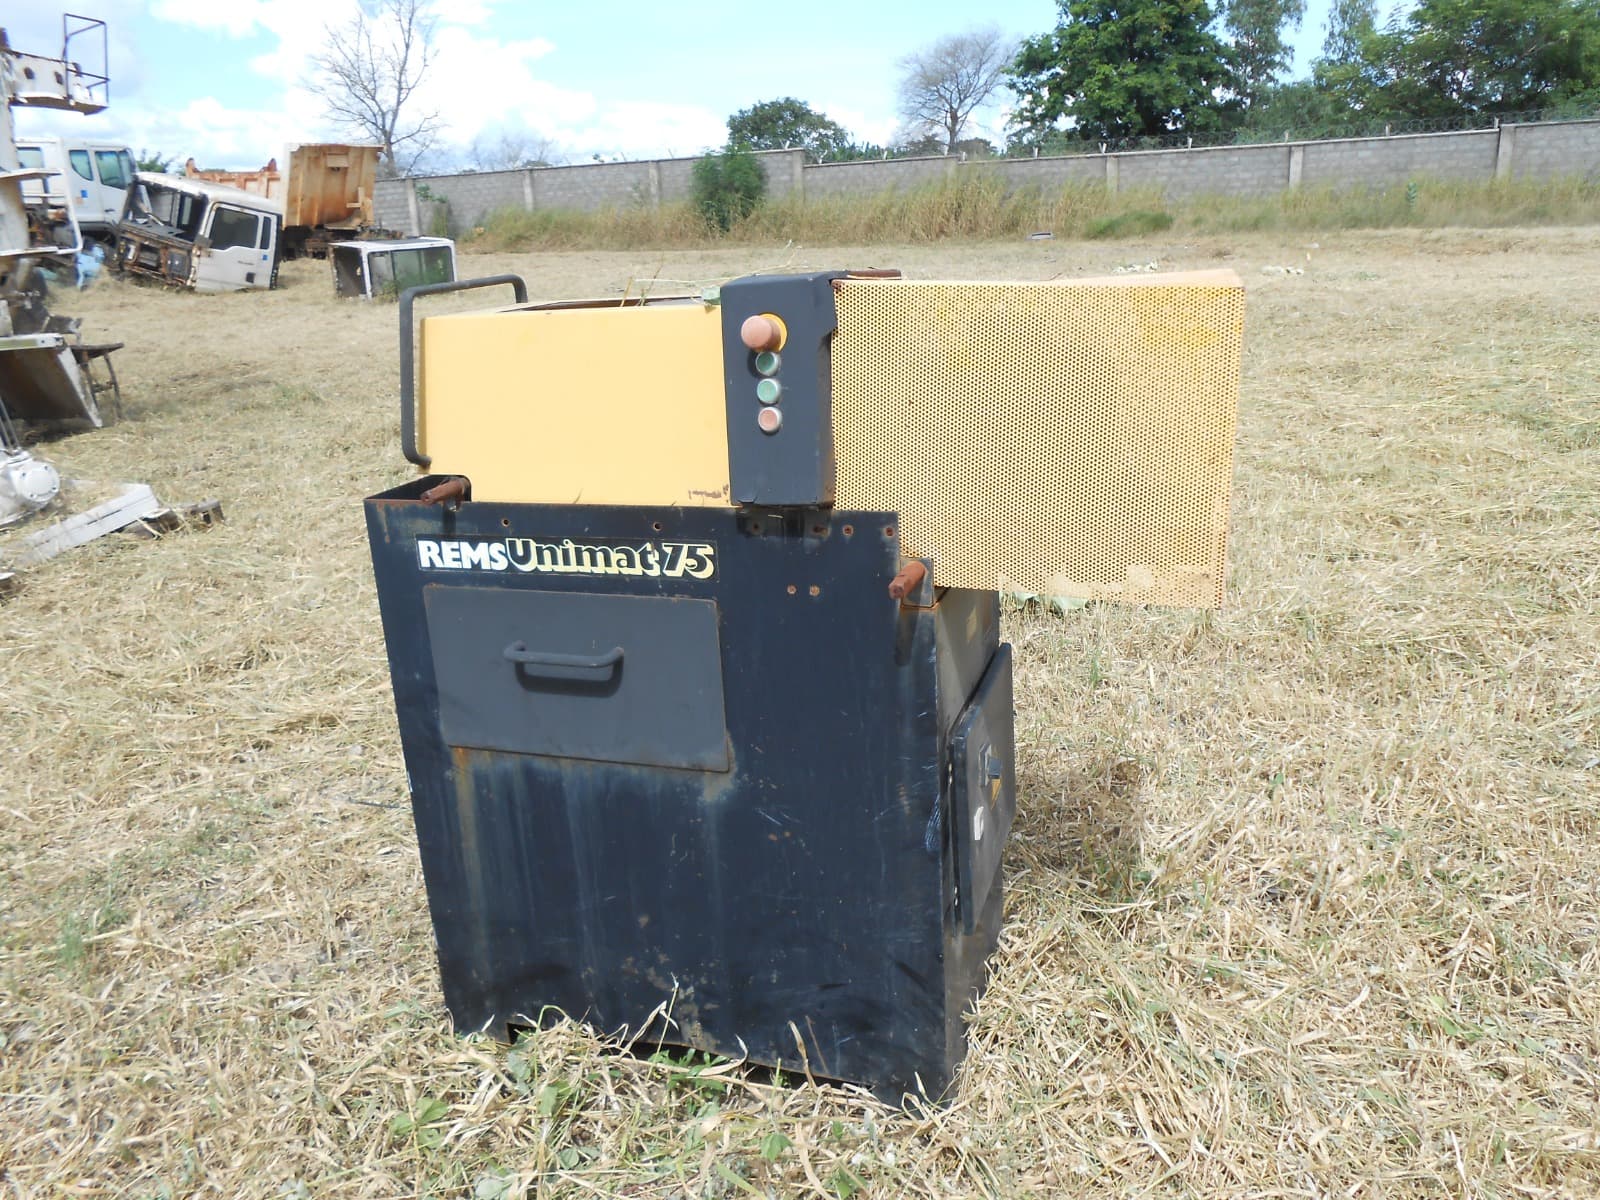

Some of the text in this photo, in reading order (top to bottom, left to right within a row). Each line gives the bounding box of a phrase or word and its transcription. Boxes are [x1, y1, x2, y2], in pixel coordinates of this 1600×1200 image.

[418, 538, 715, 579] REMS Unimat 75
